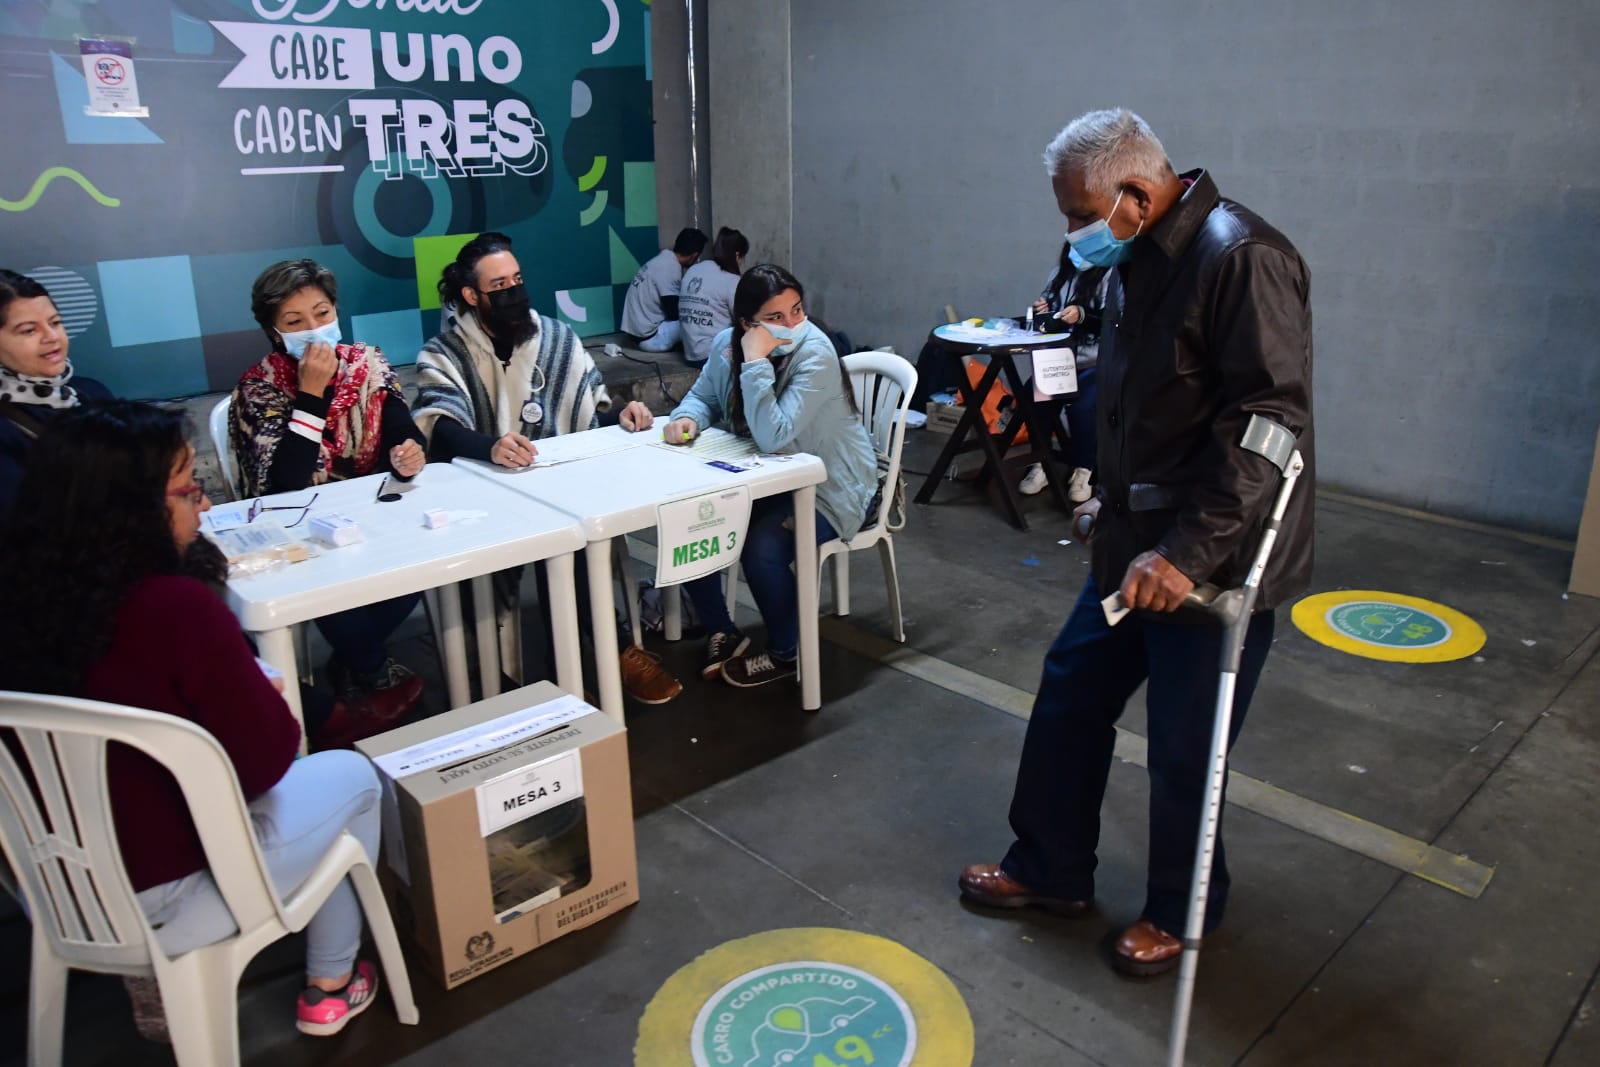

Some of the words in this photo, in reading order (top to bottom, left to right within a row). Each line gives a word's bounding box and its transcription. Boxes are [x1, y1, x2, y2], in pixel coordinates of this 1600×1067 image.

[270, 32, 349, 81] CABE
[380, 31, 523, 84] uno
[234, 105, 343, 154] CABEN
[349, 99, 544, 176] TRES
[672, 536, 720, 568] MESA
[726, 531, 737, 551] 3
[503, 786, 548, 813] MESA
[553, 781, 562, 793] 3
[712, 1012, 736, 1064] CARRO
[729, 971, 858, 1009] COMPARTIDO
